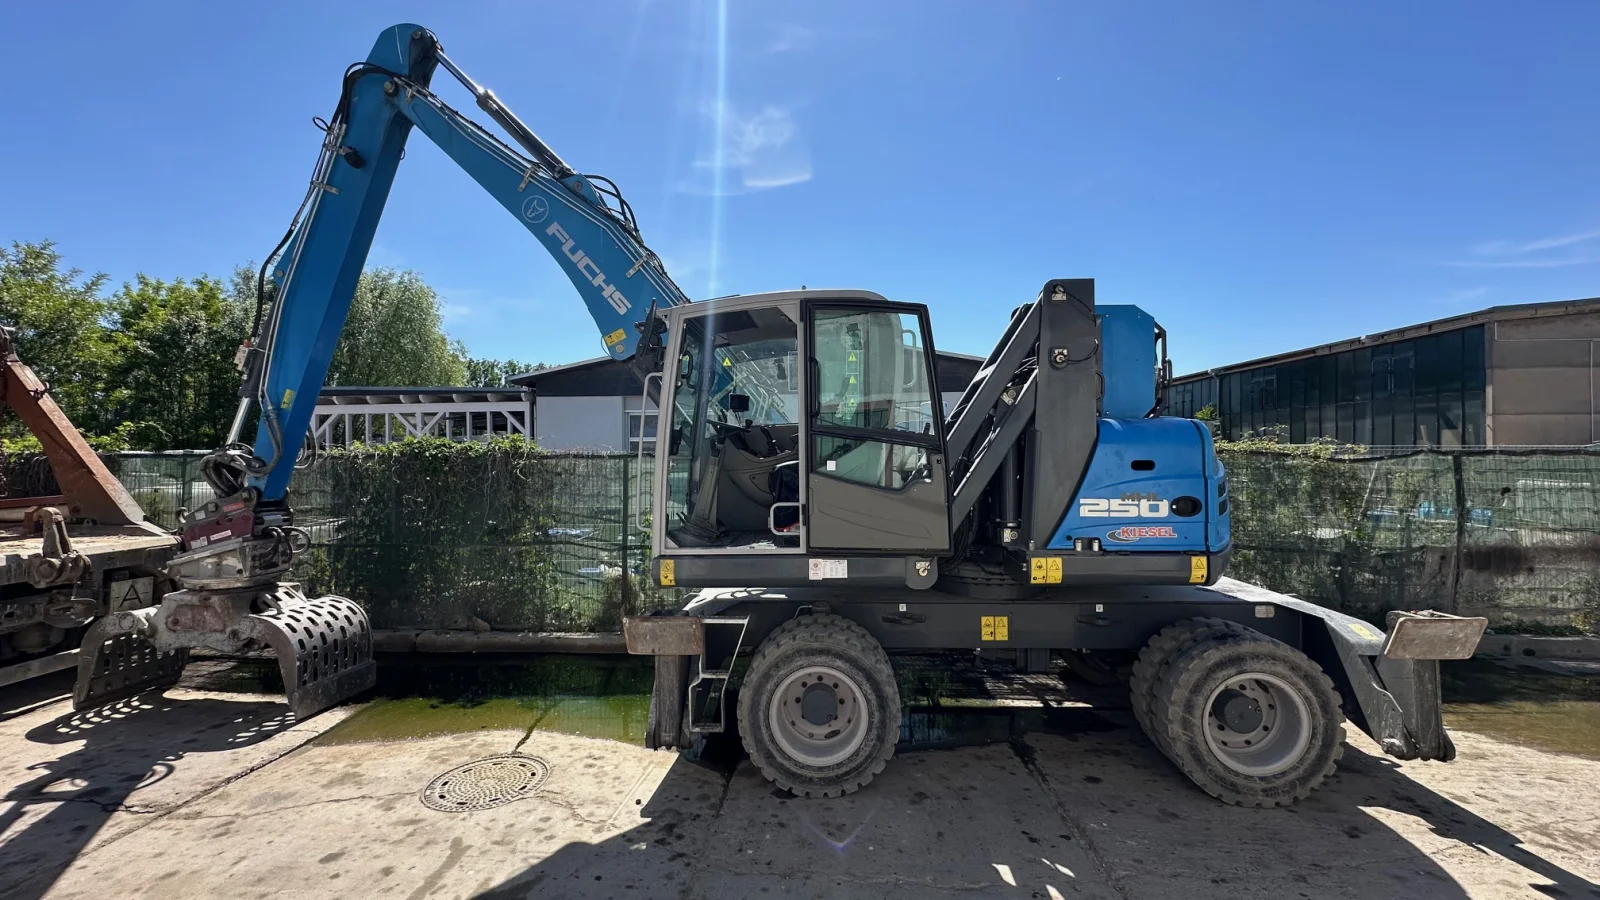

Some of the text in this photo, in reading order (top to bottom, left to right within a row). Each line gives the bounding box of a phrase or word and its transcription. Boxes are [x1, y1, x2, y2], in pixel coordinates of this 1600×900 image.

[546, 221, 632, 315] FUCHS
[1079, 499, 1169, 517] 250
[1120, 526, 1177, 538] KIESEL
[119, 584, 142, 608] A
